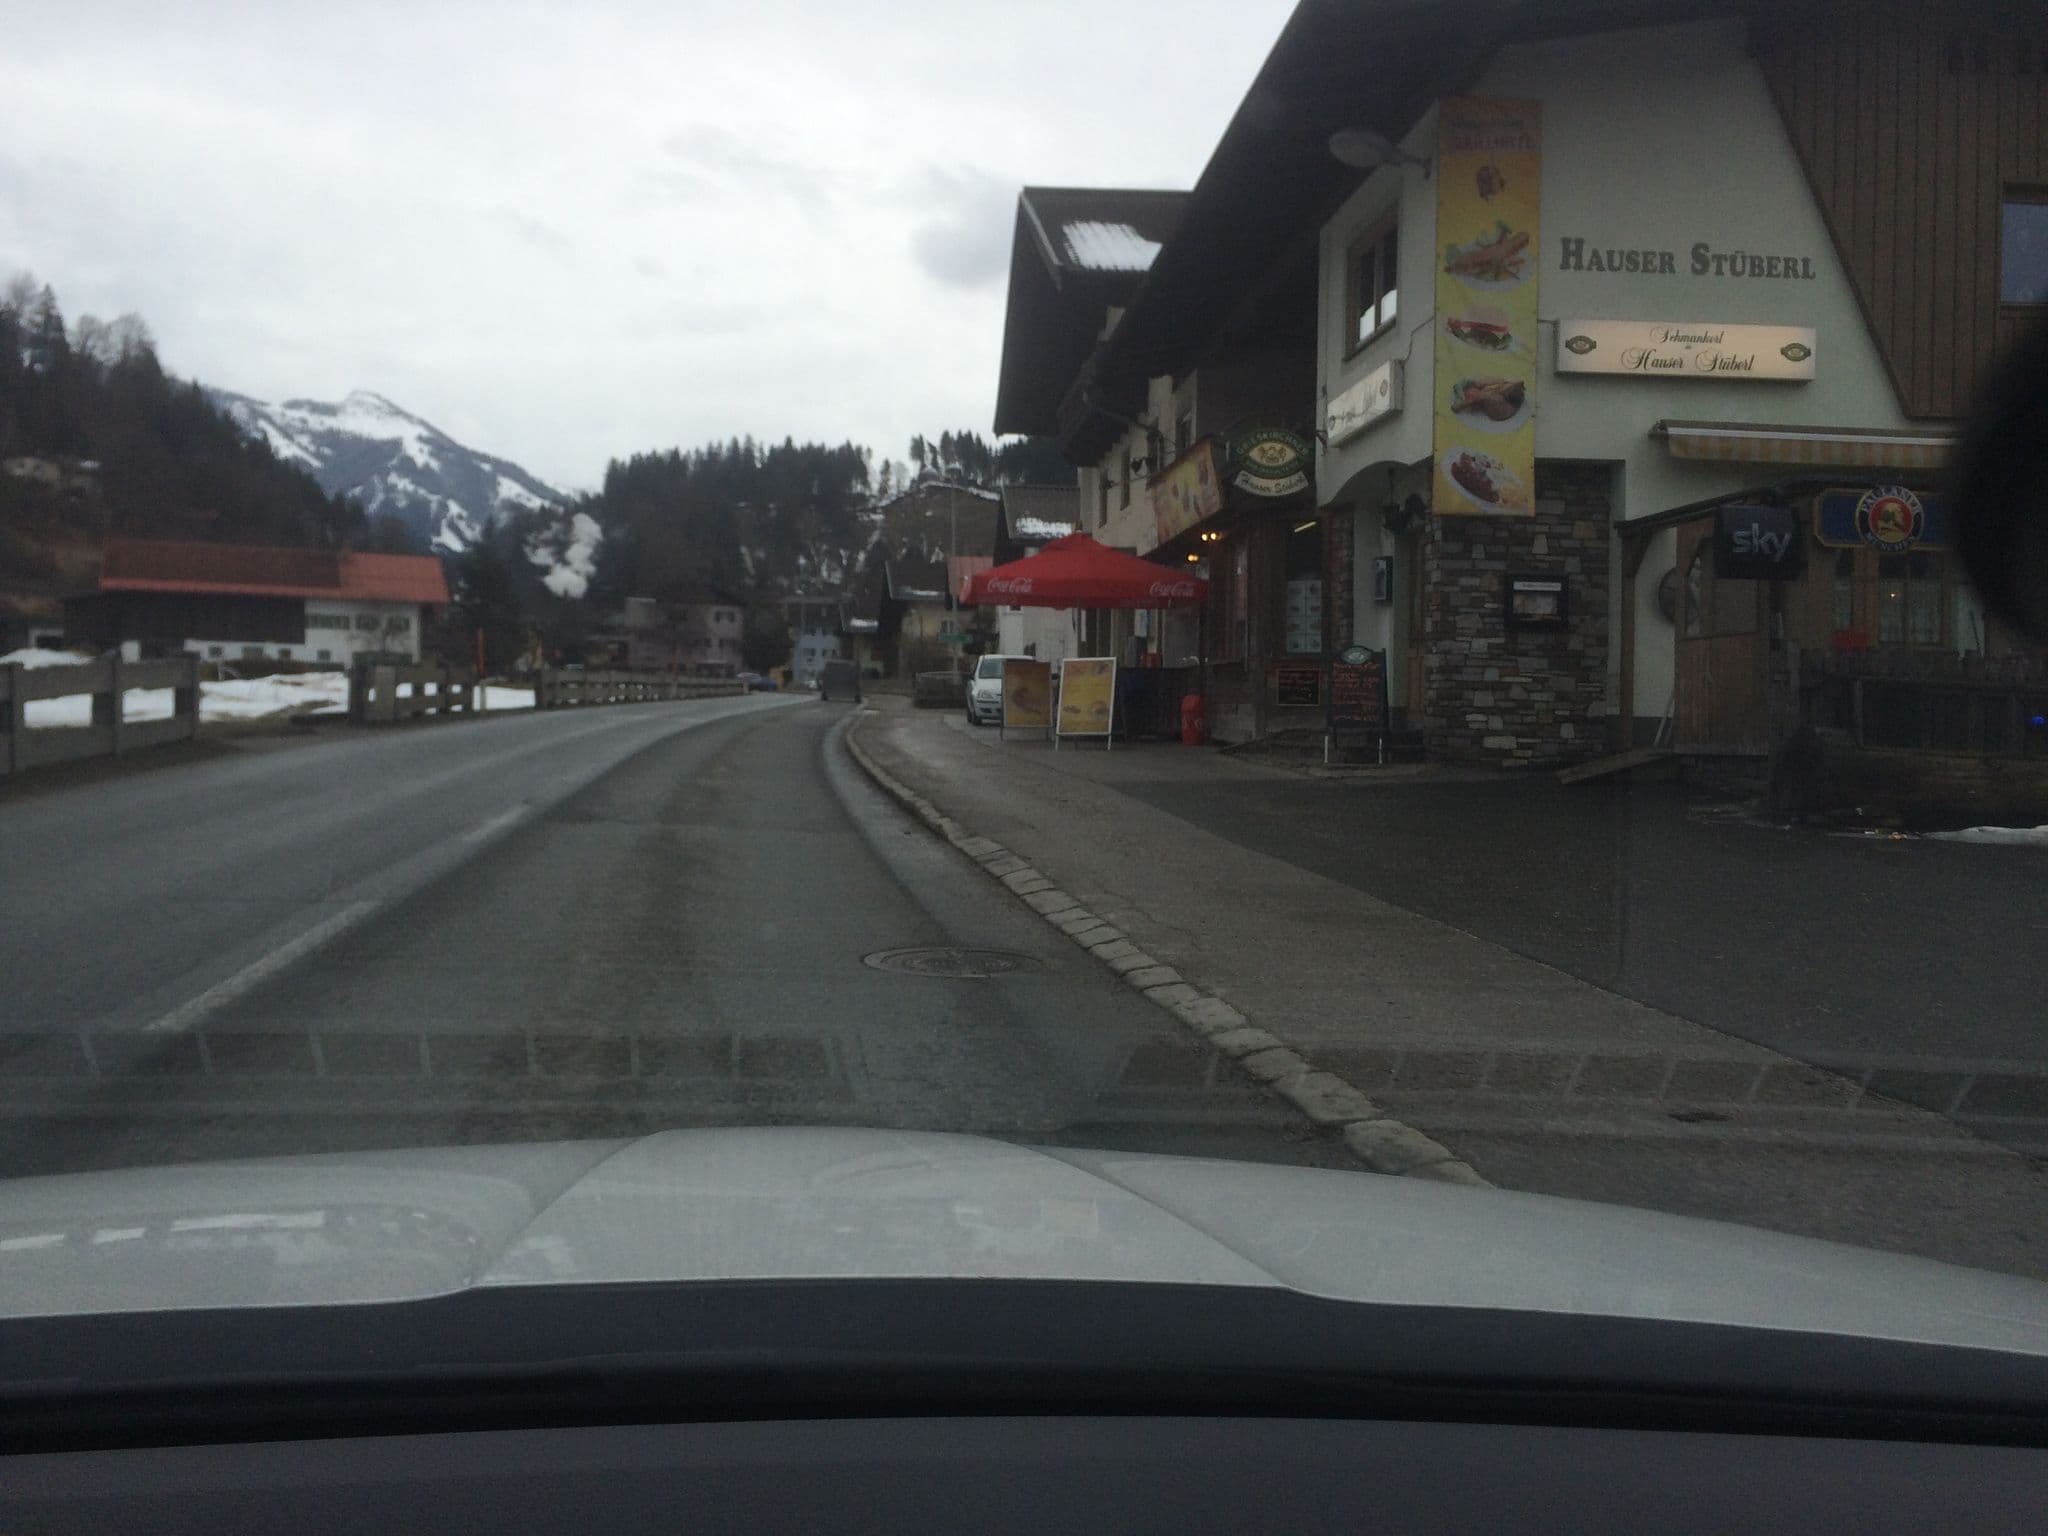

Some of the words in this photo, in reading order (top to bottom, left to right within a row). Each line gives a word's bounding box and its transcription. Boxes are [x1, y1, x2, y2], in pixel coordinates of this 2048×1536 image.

[1559, 237, 1677, 275] HAUSER
[1690, 242, 1816, 280] STÜBERL
[1621, 347, 1685, 370] Hauser
[1695, 349, 1755, 372] Stüberl
[1732, 522, 1792, 563] sky
